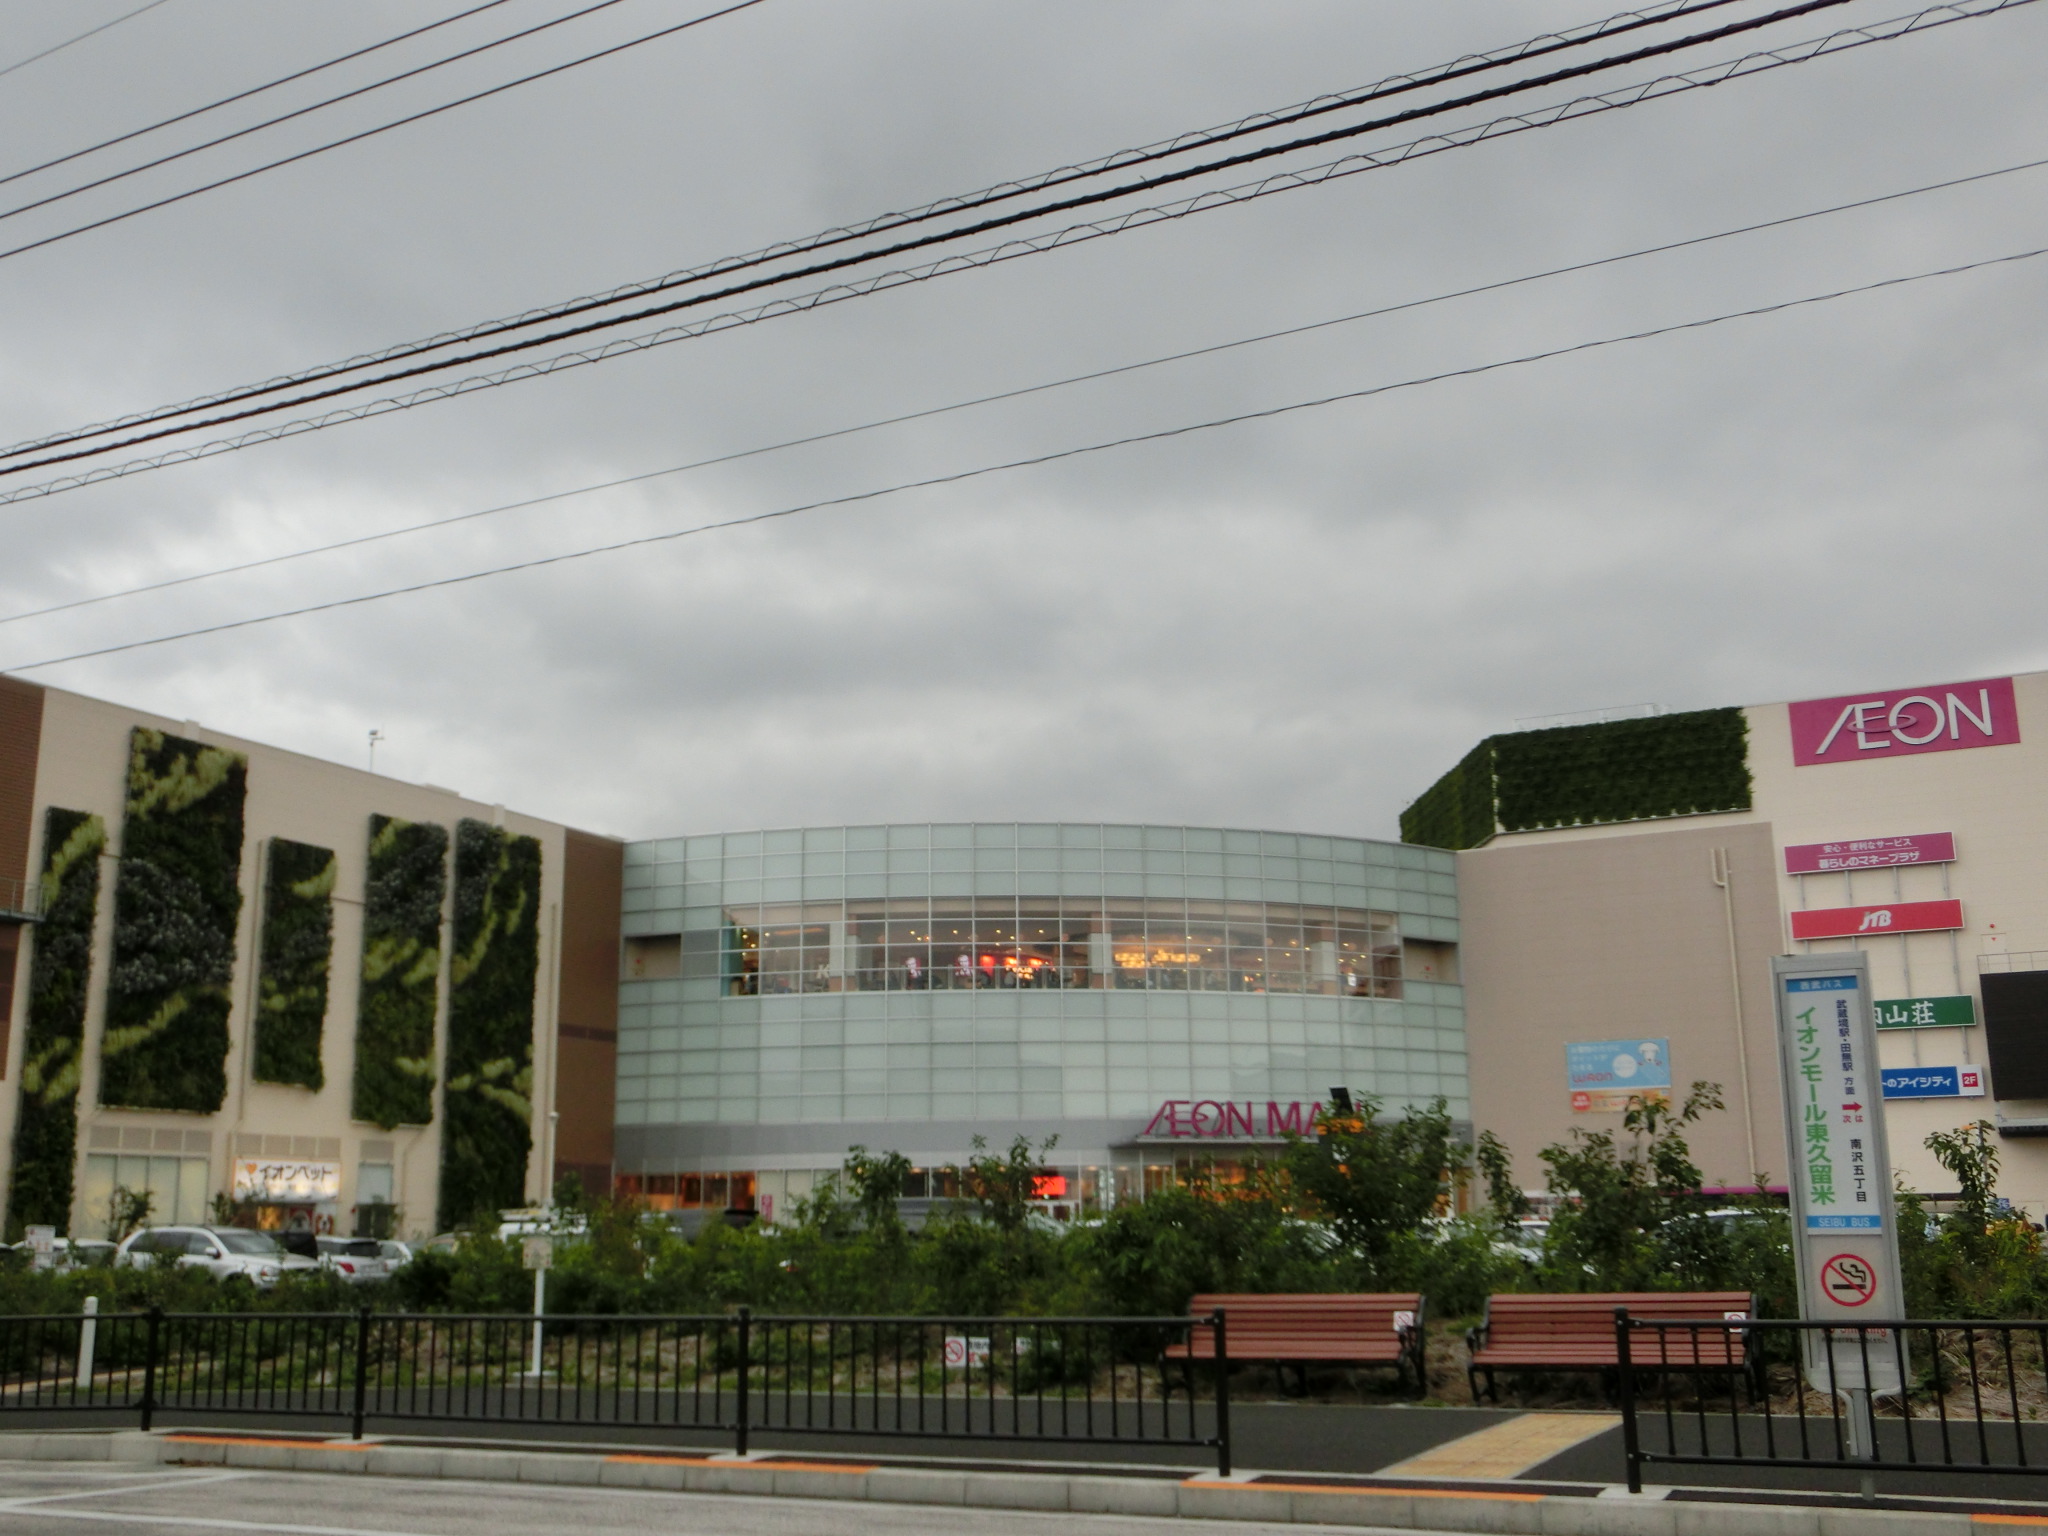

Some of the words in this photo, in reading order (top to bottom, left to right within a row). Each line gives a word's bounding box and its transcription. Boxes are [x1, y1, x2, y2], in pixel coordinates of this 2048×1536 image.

[1819, 851, 1920, 869] 暮らしのマネープラザ
[1858, 909, 1892, 931] JTB
[1963, 1076, 1976, 1085] 2F
[1796, 1006, 1835, 1205] イオンモール東久留米
[1850, 1139, 1866, 1202] 南沢五丁目
[1818, 1218, 1845, 1227] SEIBU
[1851, 1218, 1870, 1227] BUS
